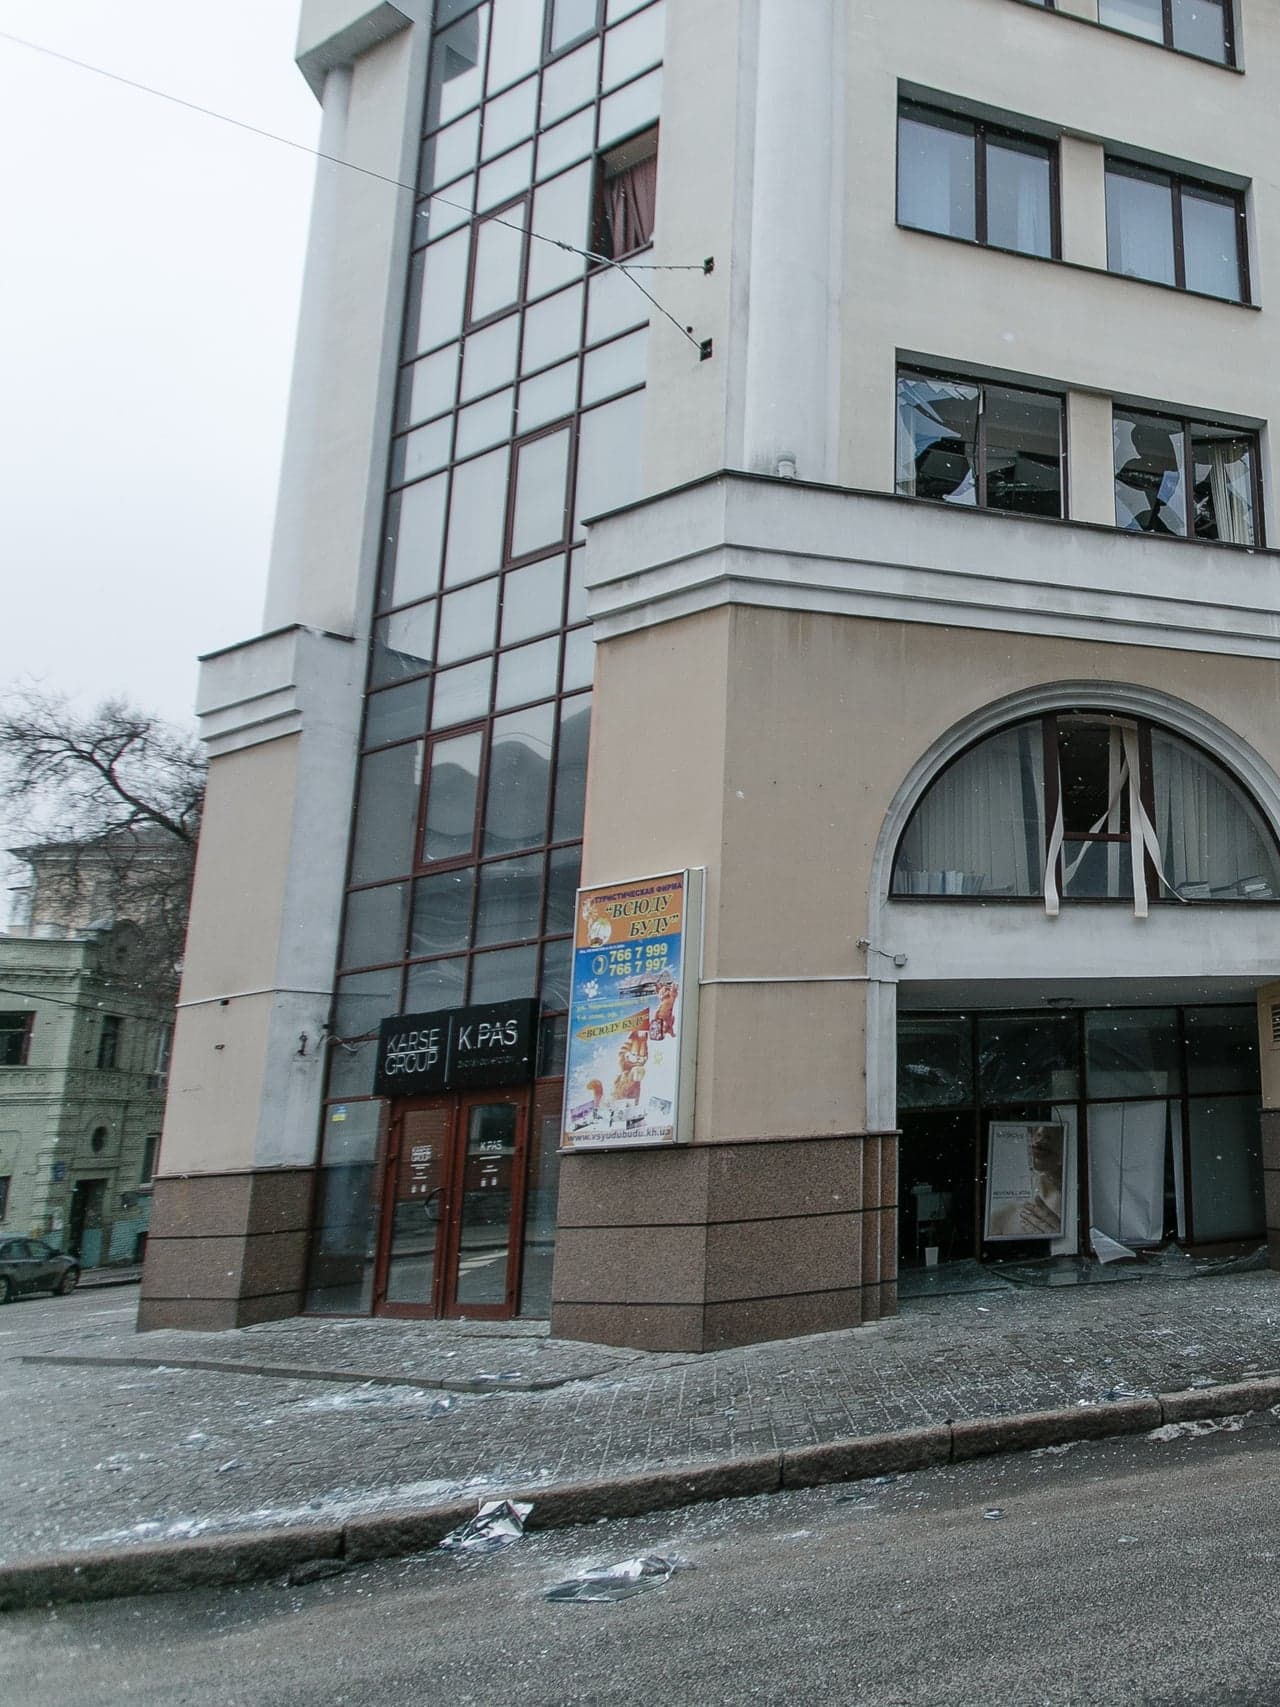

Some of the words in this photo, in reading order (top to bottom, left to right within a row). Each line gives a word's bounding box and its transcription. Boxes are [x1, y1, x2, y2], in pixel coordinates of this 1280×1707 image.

[609, 948, 632, 963] 766
[635, 946, 643, 959] 7
[646, 942, 668, 957] 999
[608, 962, 632, 977] 766
[634, 960, 643, 973] 7
[645, 957, 667, 971] 997
[387, 1028, 440, 1052] KARSE
[385, 1050, 438, 1075] GROUP
[567, 1126, 671, 1142] www.vsyudubudu.kh.ua
